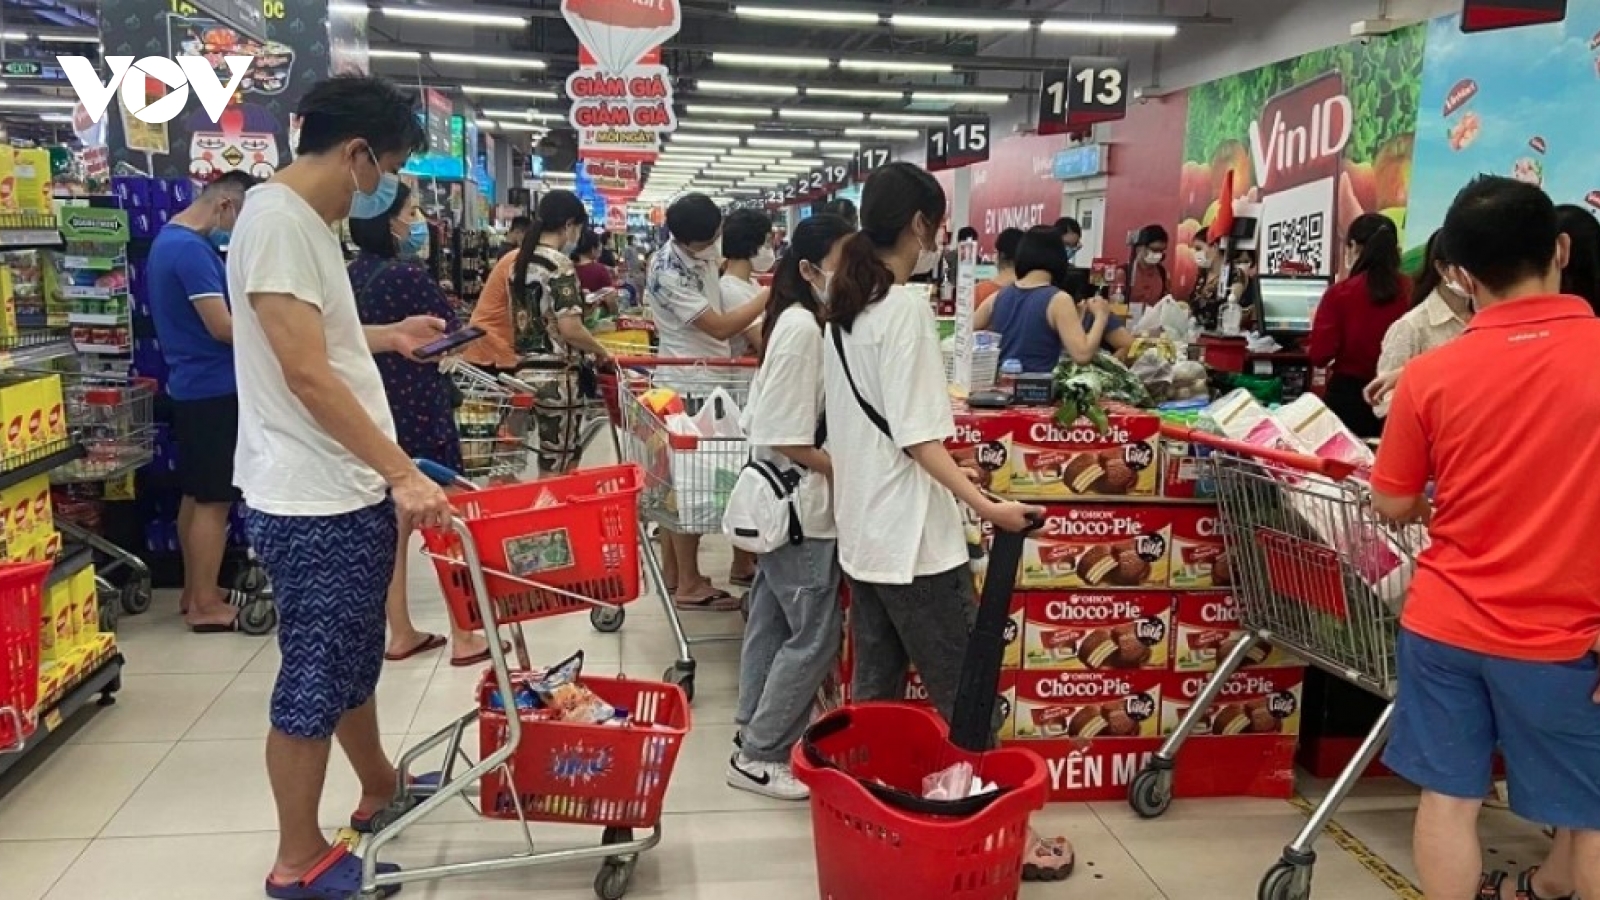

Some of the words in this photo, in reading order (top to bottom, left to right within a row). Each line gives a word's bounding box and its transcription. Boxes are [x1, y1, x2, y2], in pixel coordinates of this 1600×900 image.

[629, 74, 667, 97] GIÁ
[1047, 81, 1067, 114] 1
[1076, 68, 1122, 104] 13
[634, 102, 670, 126] GIÁ
[953, 124, 986, 150] 15
[1249, 95, 1352, 188] VinID
[863, 149, 888, 168] 17
[825, 166, 846, 182] 19
